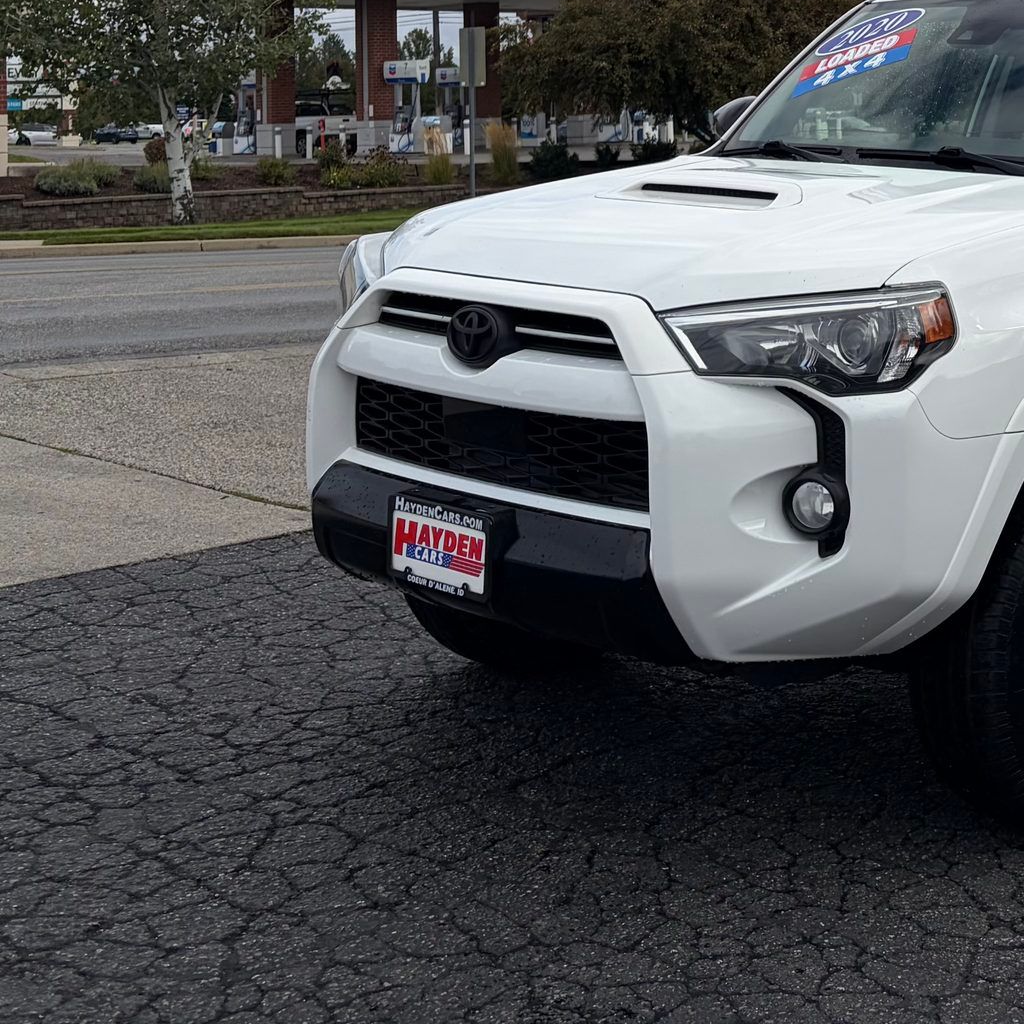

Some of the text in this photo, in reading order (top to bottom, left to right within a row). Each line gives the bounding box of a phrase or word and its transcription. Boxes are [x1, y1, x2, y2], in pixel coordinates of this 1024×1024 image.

[829, 12, 909, 52] 2020
[813, 34, 900, 74] LOADED
[813, 69, 835, 86] 4
[864, 52, 887, 68] 4
[393, 517, 484, 561] HAYDEN
[415, 546, 444, 566] CARS
[407, 574, 428, 586] COEUR
